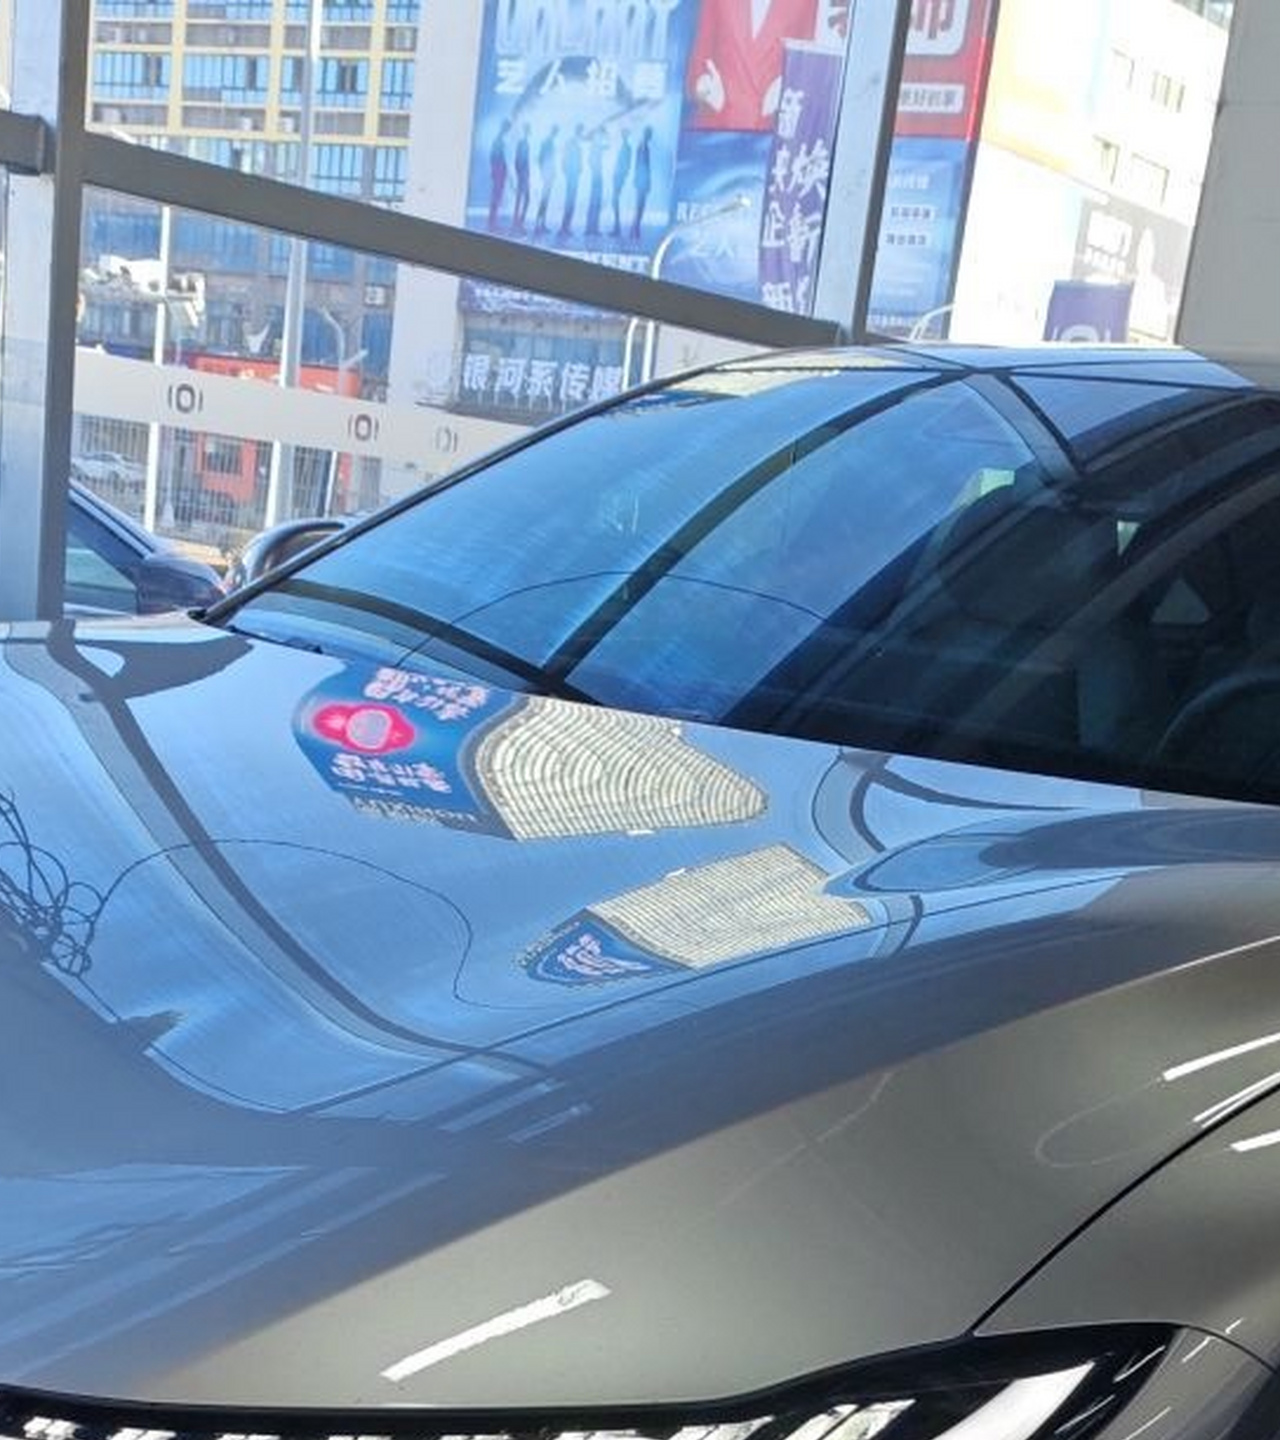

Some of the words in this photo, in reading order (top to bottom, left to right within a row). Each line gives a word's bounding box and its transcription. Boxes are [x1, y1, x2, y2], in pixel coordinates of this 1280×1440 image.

[463, 354, 622, 402] 银河系传媒
